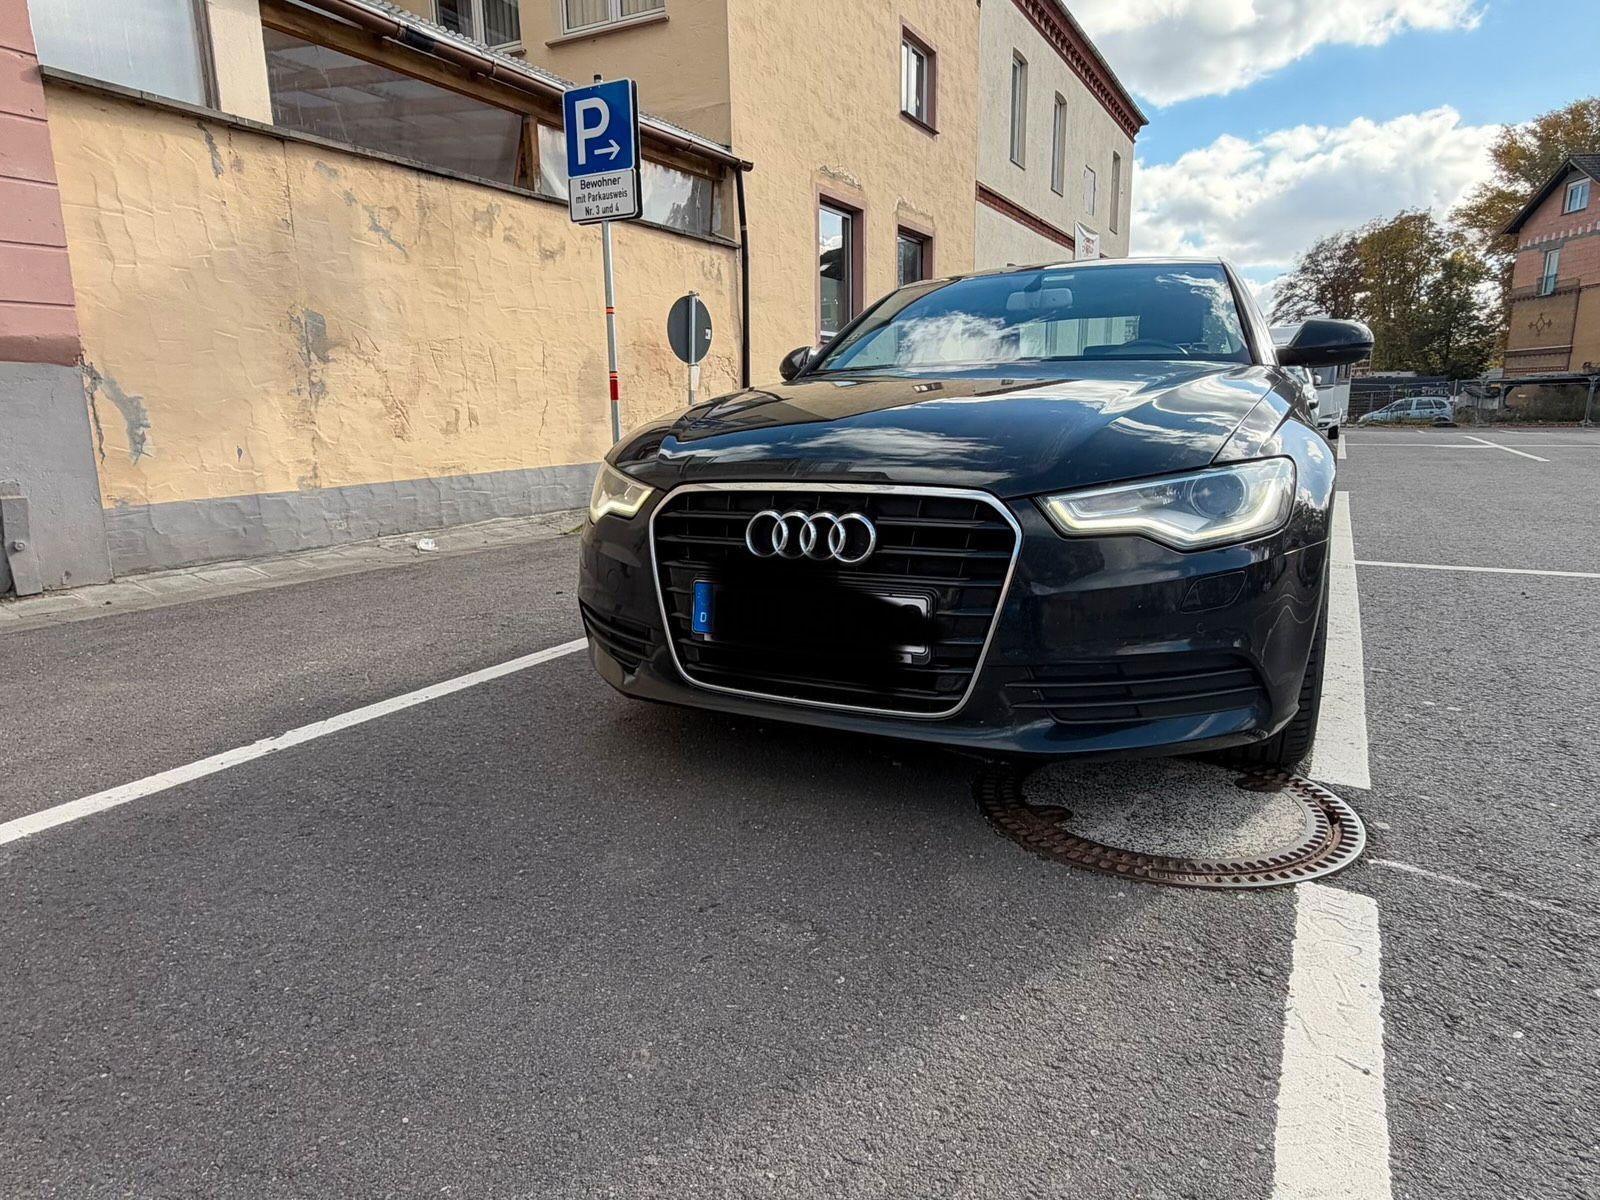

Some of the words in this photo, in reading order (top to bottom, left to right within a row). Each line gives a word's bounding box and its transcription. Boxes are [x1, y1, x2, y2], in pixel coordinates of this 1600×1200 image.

[575, 97, 610, 165] P
[580, 177, 621, 190] Bewohner
[575, 194, 586, 204] mit
[587, 188, 628, 202] Parkausweis
[585, 206, 594, 216] Nr.
[595, 205, 600, 215] 3
[601, 203, 613, 213] und
[615, 202, 620, 212] 4
[700, 612, 707, 622] D
